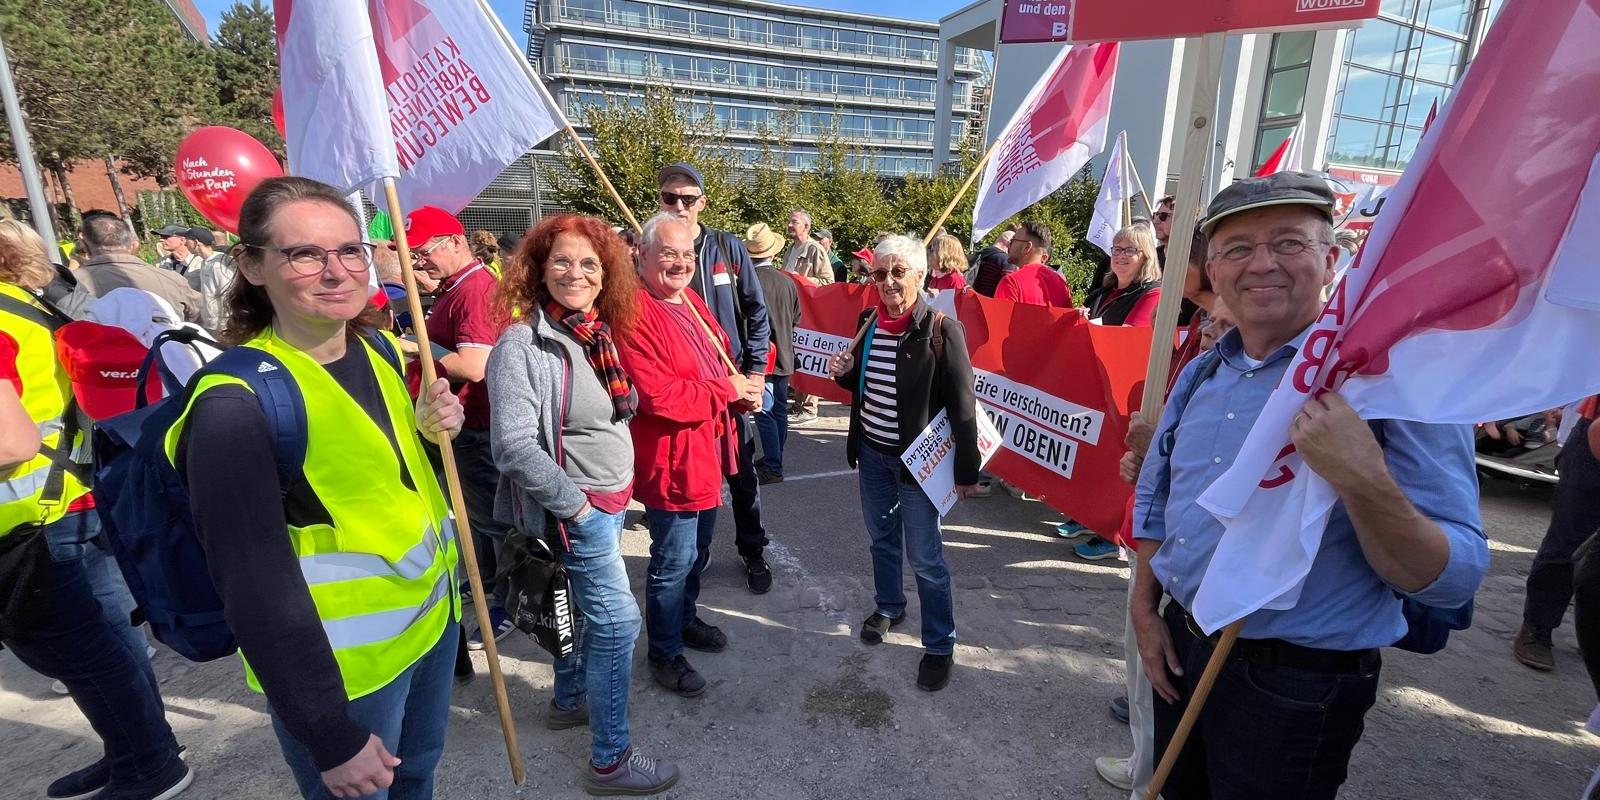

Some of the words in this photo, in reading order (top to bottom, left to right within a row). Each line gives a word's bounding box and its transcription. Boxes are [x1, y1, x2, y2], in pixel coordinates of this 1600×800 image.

[1018, 3, 1041, 14] und
[1043, 3, 1066, 15] den
[183, 157, 208, 169] Nach
[187, 167, 235, 180] Stunden
[204, 177, 237, 192] Papi
[792, 332, 809, 346] Bei
[813, 337, 834, 352] den
[99, 368, 140, 378] ver.d
[1002, 388, 1092, 437] verschonen?
[920, 434, 943, 462] statt
[1013, 423, 1071, 471] OBEN!
[554, 589, 572, 641] MUSIK
